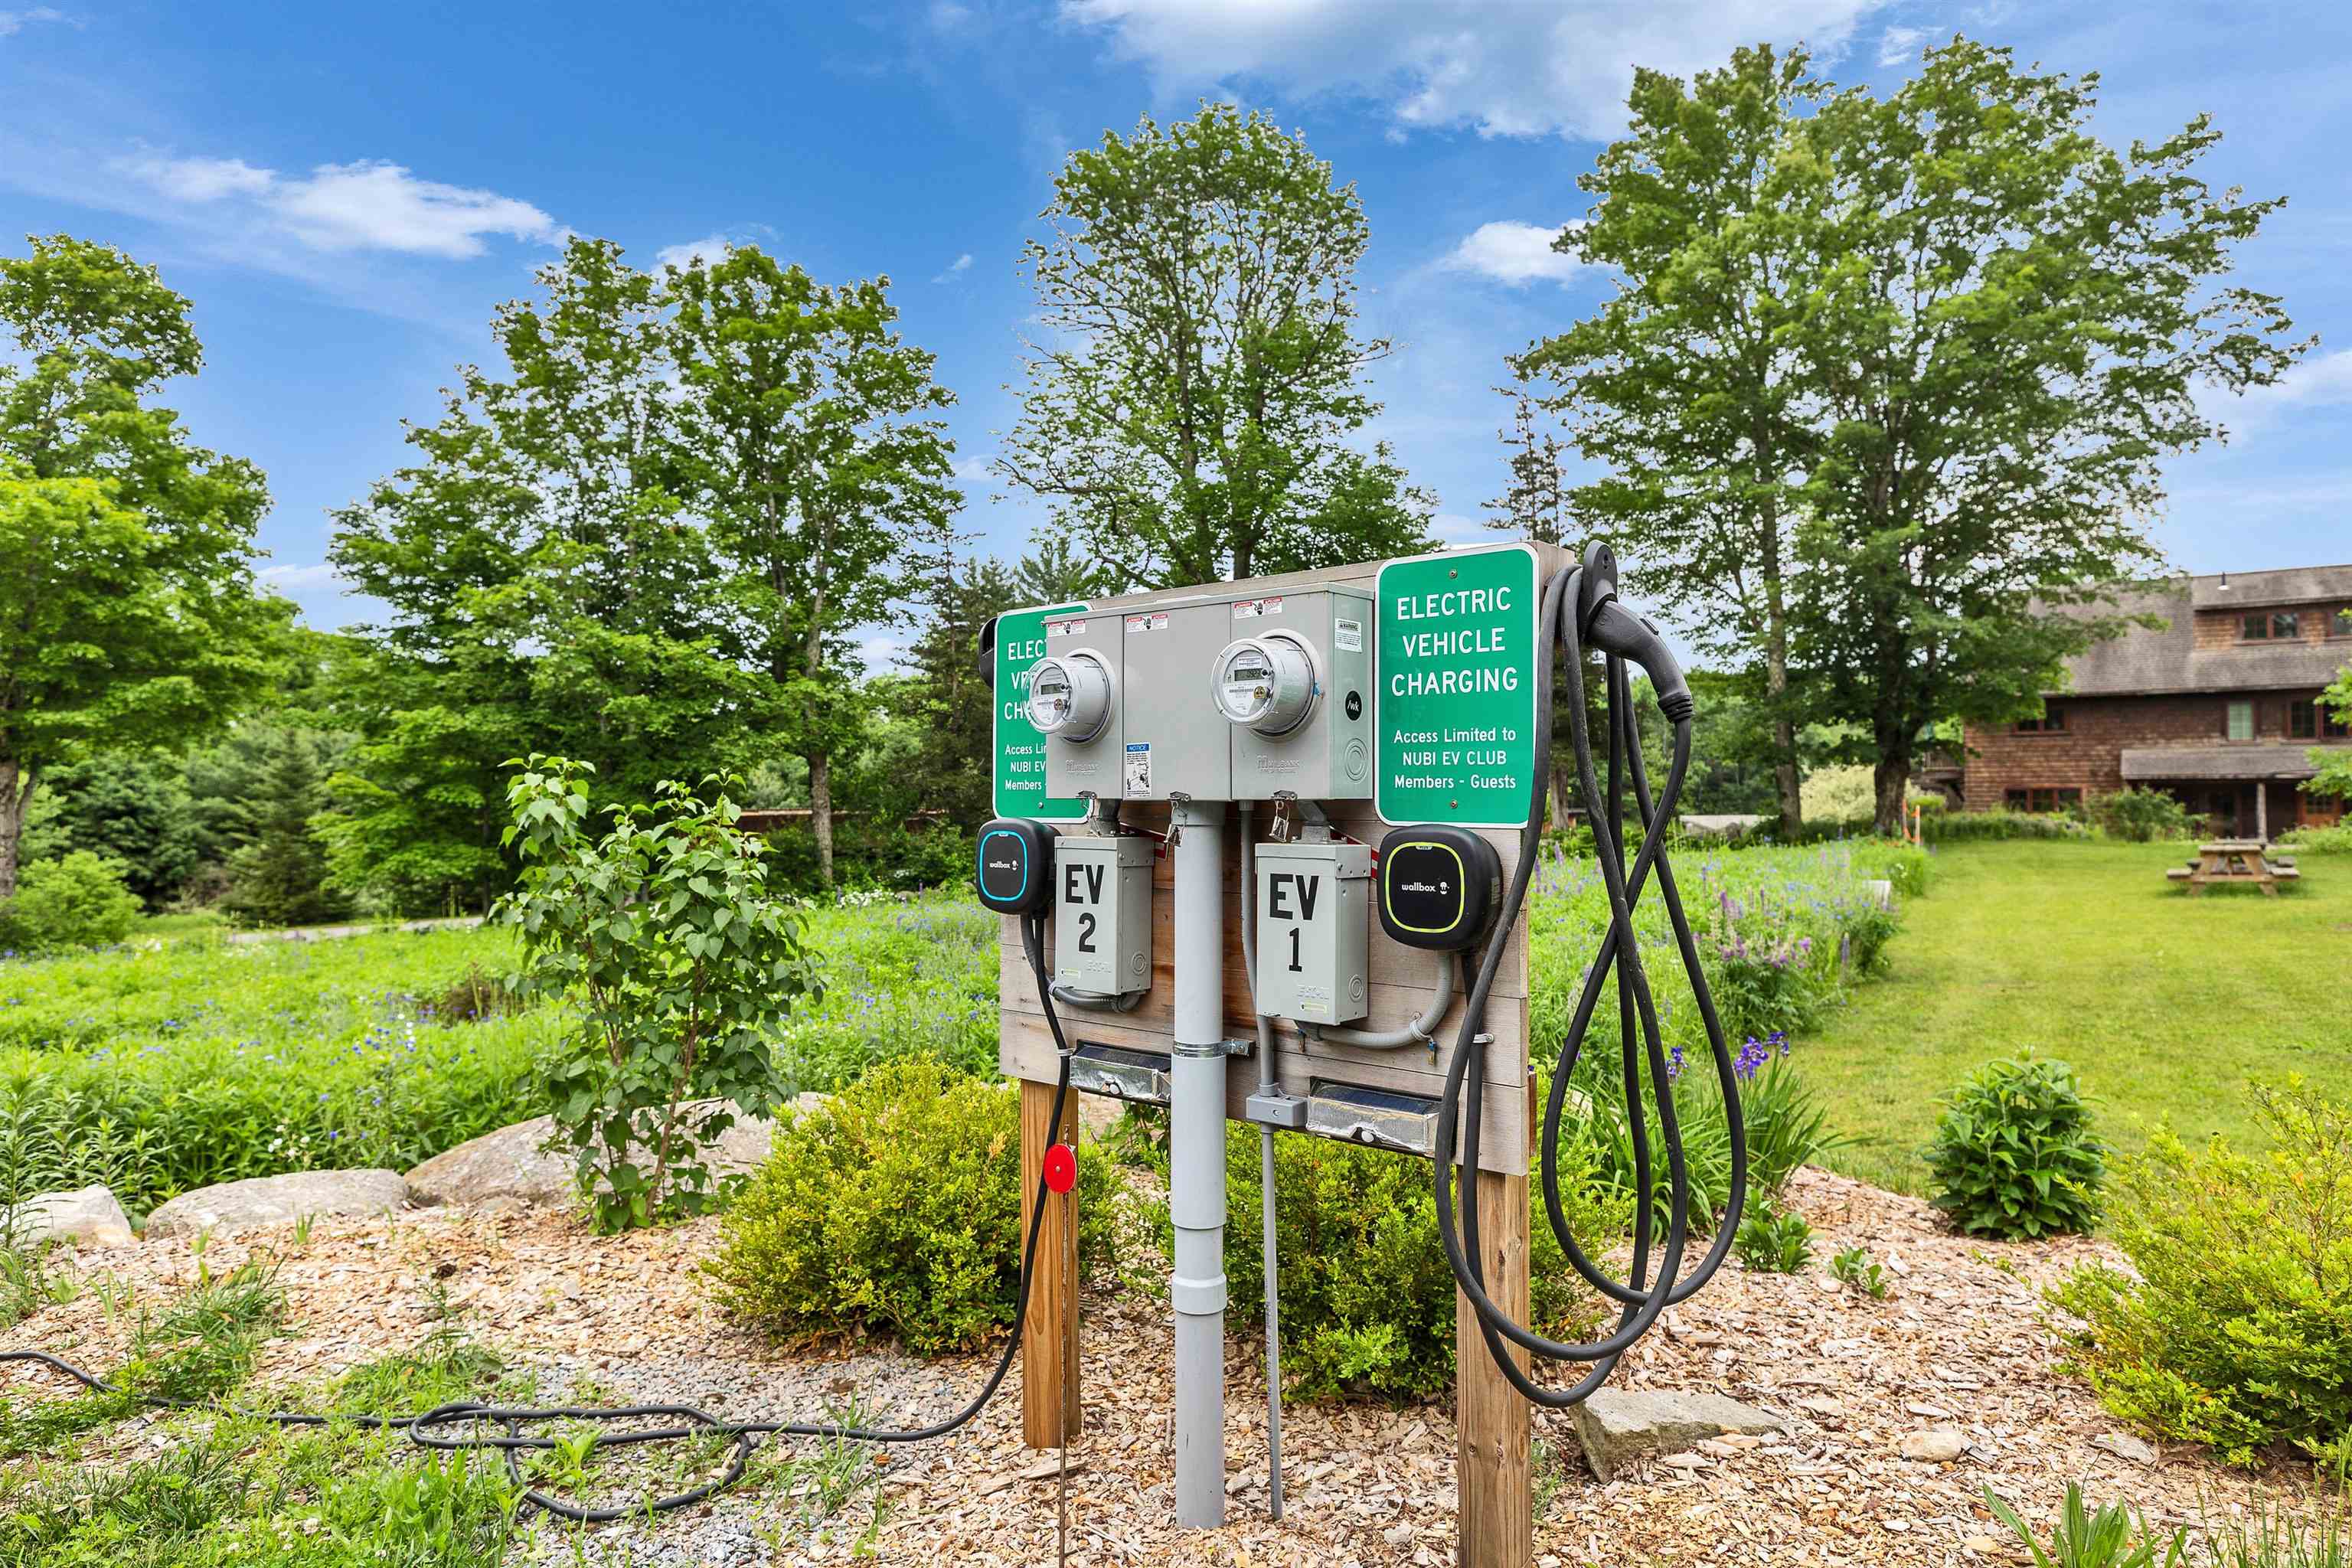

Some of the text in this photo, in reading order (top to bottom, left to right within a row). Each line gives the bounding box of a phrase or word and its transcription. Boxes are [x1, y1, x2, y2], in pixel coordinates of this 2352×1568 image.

[1397, 586, 1511, 620] ELECTRIC
[1008, 639, 1047, 661] ELEC
[1403, 627, 1505, 658] VEHICLE
[1391, 667, 1518, 697] CHARGING
[1393, 727, 1517, 743] Access Limited to
[1004, 743, 1032, 755] Access
[1403, 750, 1507, 766] NUBI EV CLUB
[1011, 760, 1046, 773] NUBI EV
[1004, 779, 1042, 791] Members
[1394, 774, 1455, 789] Members
[1470, 774, 1517, 789] Guests
[1065, 864, 1105, 905] EV
[1401, 881, 1437, 893] wallbox
[1269, 873, 1320, 920] EV
[1078, 912, 1096, 953] 2
[1289, 927, 1302, 972] 1
